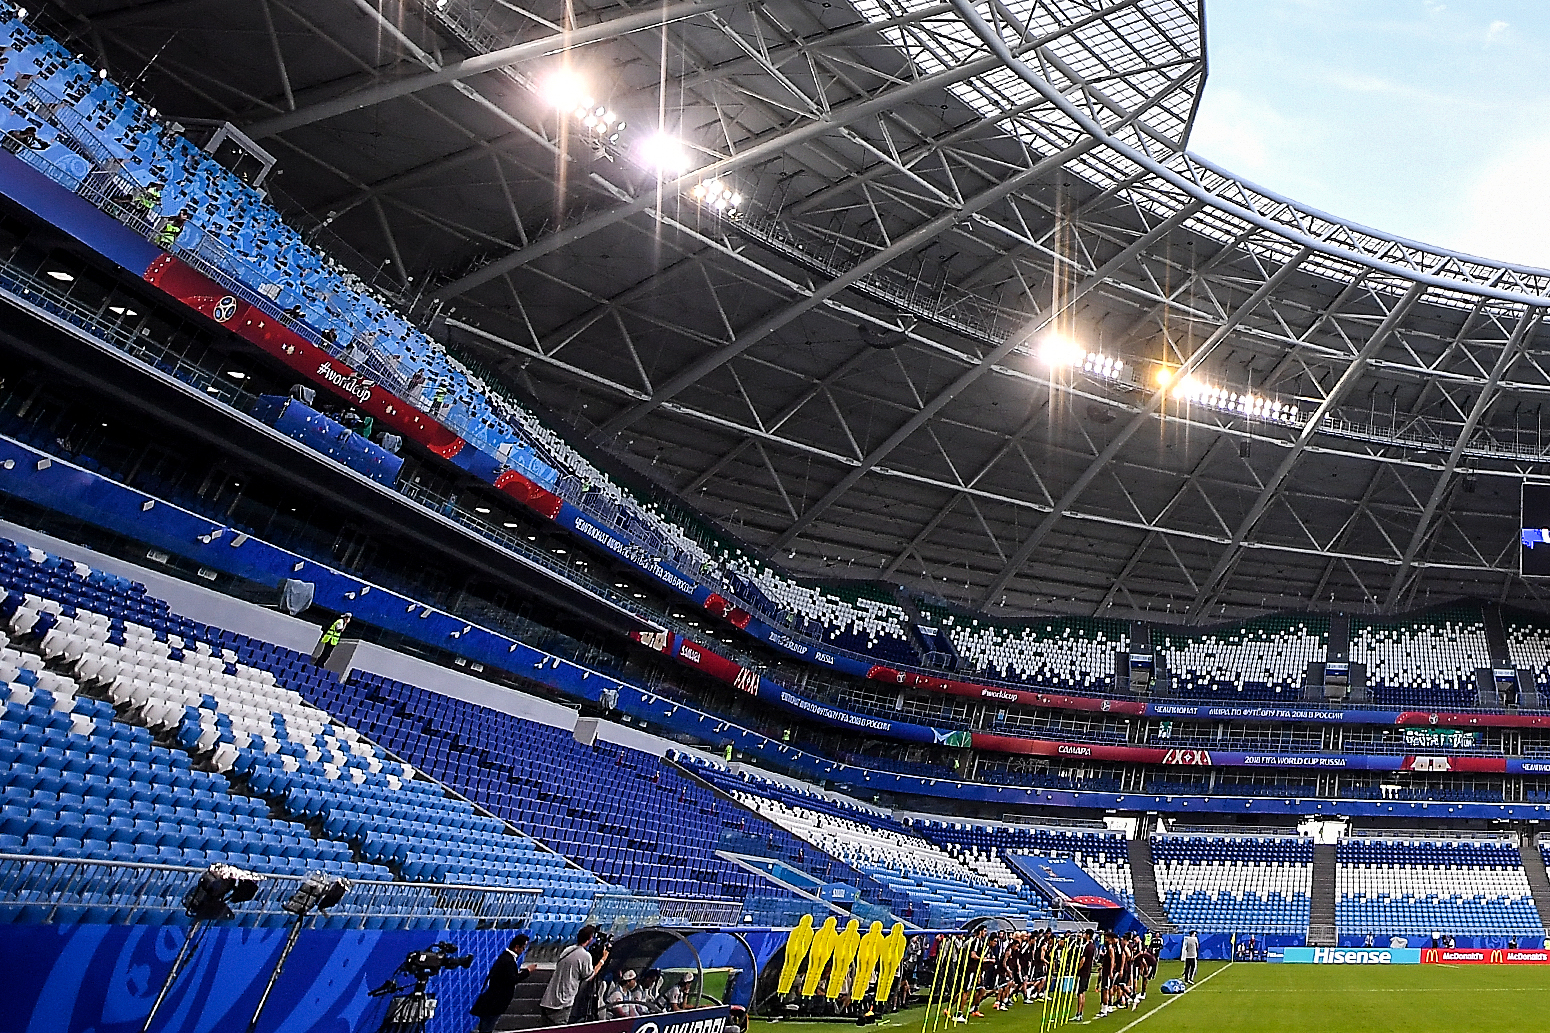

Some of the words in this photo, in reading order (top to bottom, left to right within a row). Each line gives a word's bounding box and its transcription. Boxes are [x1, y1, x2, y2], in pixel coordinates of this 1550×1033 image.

[317, 362, 371, 403] #worldcup
[982, 689, 1017, 701] #worldcup
[1058, 746, 1091, 755] САМАРА
[1244, 756, 1260, 764] 2018
[1277, 757, 1303, 765] WORLD
[1303, 757, 1318, 765] CUP
[1319, 758, 1346, 766] RUSSIA
[1313, 947, 1392, 964] Hisense
[1442, 952, 1484, 961] McDonald's
[1507, 952, 1548, 961] McDonald's
